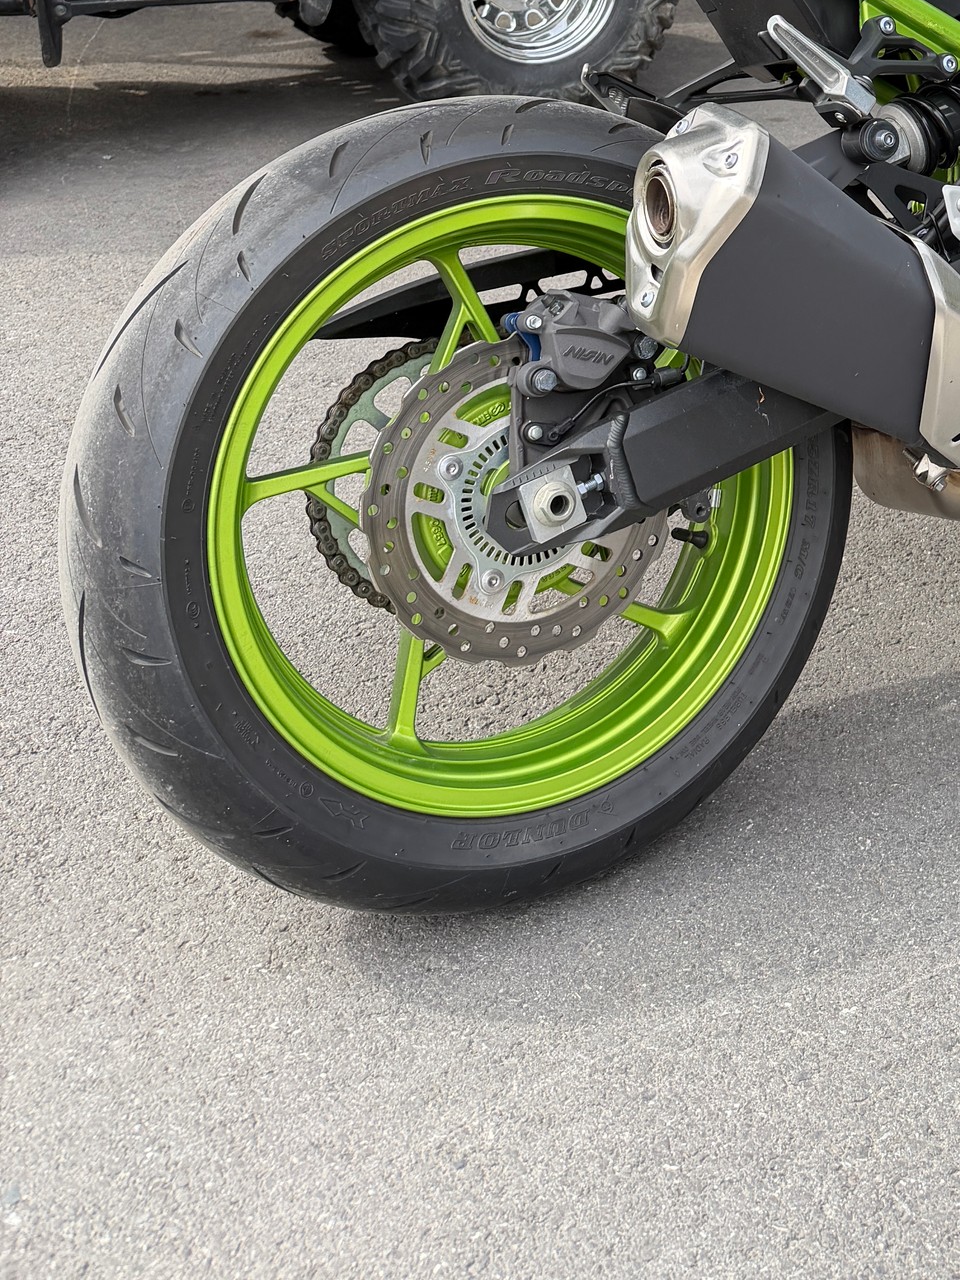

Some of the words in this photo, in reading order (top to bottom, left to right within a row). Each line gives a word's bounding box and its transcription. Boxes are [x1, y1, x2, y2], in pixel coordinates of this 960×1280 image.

[320, 174, 471, 261] SPORTMAX
[484, 166, 634, 201] Roadsp
[450, 807, 591, 851] DUNLOP
